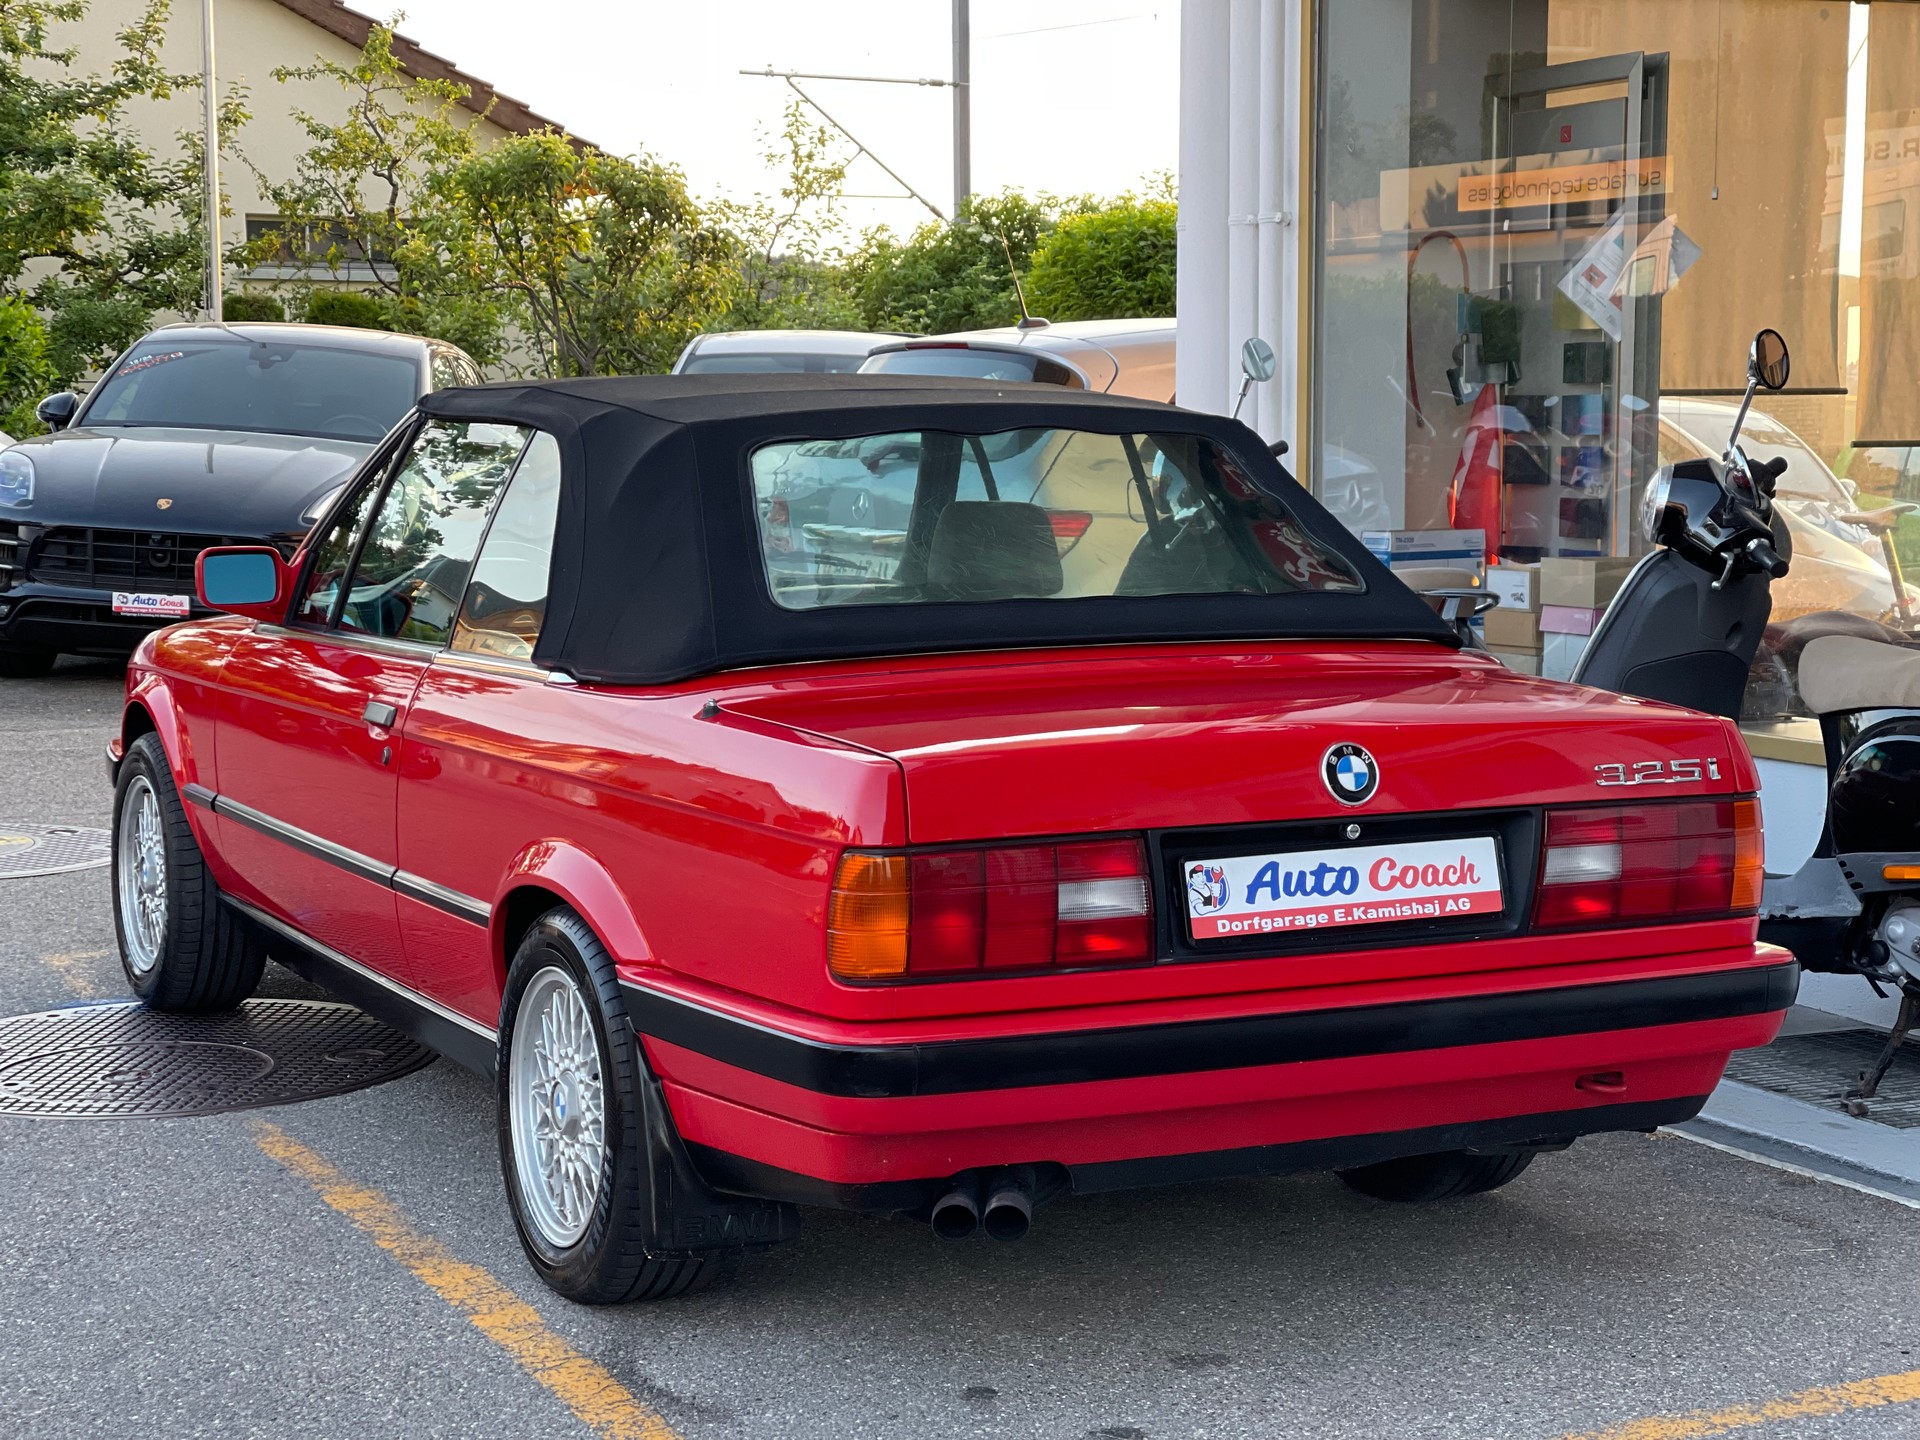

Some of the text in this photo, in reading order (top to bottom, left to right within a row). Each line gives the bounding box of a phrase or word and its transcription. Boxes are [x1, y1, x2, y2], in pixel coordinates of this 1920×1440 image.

[132, 595, 184, 608] Auto Coach
[1329, 746, 1371, 765] BMW
[1594, 757, 1721, 786] 325i
[1245, 855, 1481, 905] Auto Coach
[1216, 897, 1471, 933] Dorfgarage E.Kamishaj AG
[680, 1212, 769, 1243] BMW
